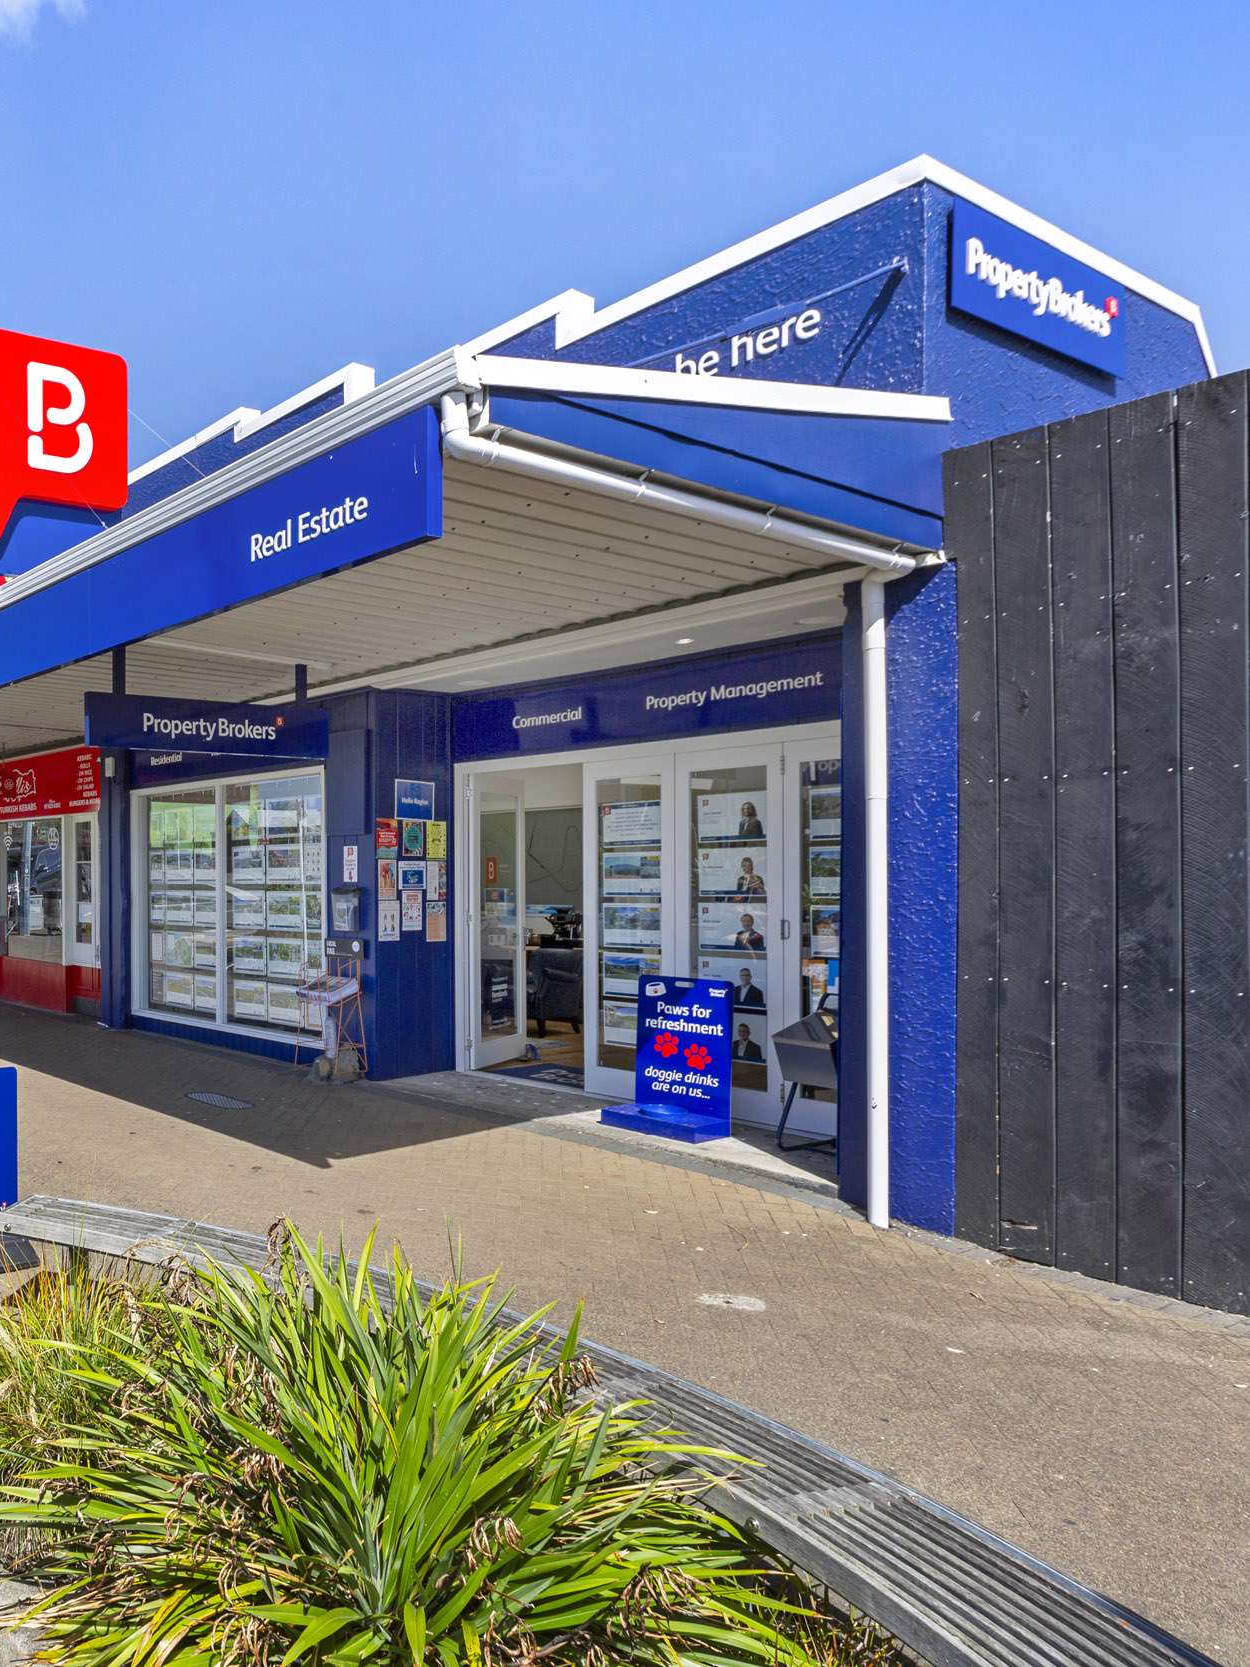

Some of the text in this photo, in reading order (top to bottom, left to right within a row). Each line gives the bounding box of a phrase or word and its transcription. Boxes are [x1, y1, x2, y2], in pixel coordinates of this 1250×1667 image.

[730, 308, 822, 367] here
[27, 361, 94, 474] B
[250, 496, 369, 562] Real Estate
[645, 671, 824, 711] Property Management
[512, 706, 582, 729] Commercial
[150, 752, 183, 766] Residential
[657, 1001, 712, 1018] Paws for
[645, 1016, 724, 1036] refreshment
[644, 1066, 719, 1087] doggie drinks
[652, 1081, 711, 1099] are on us...
